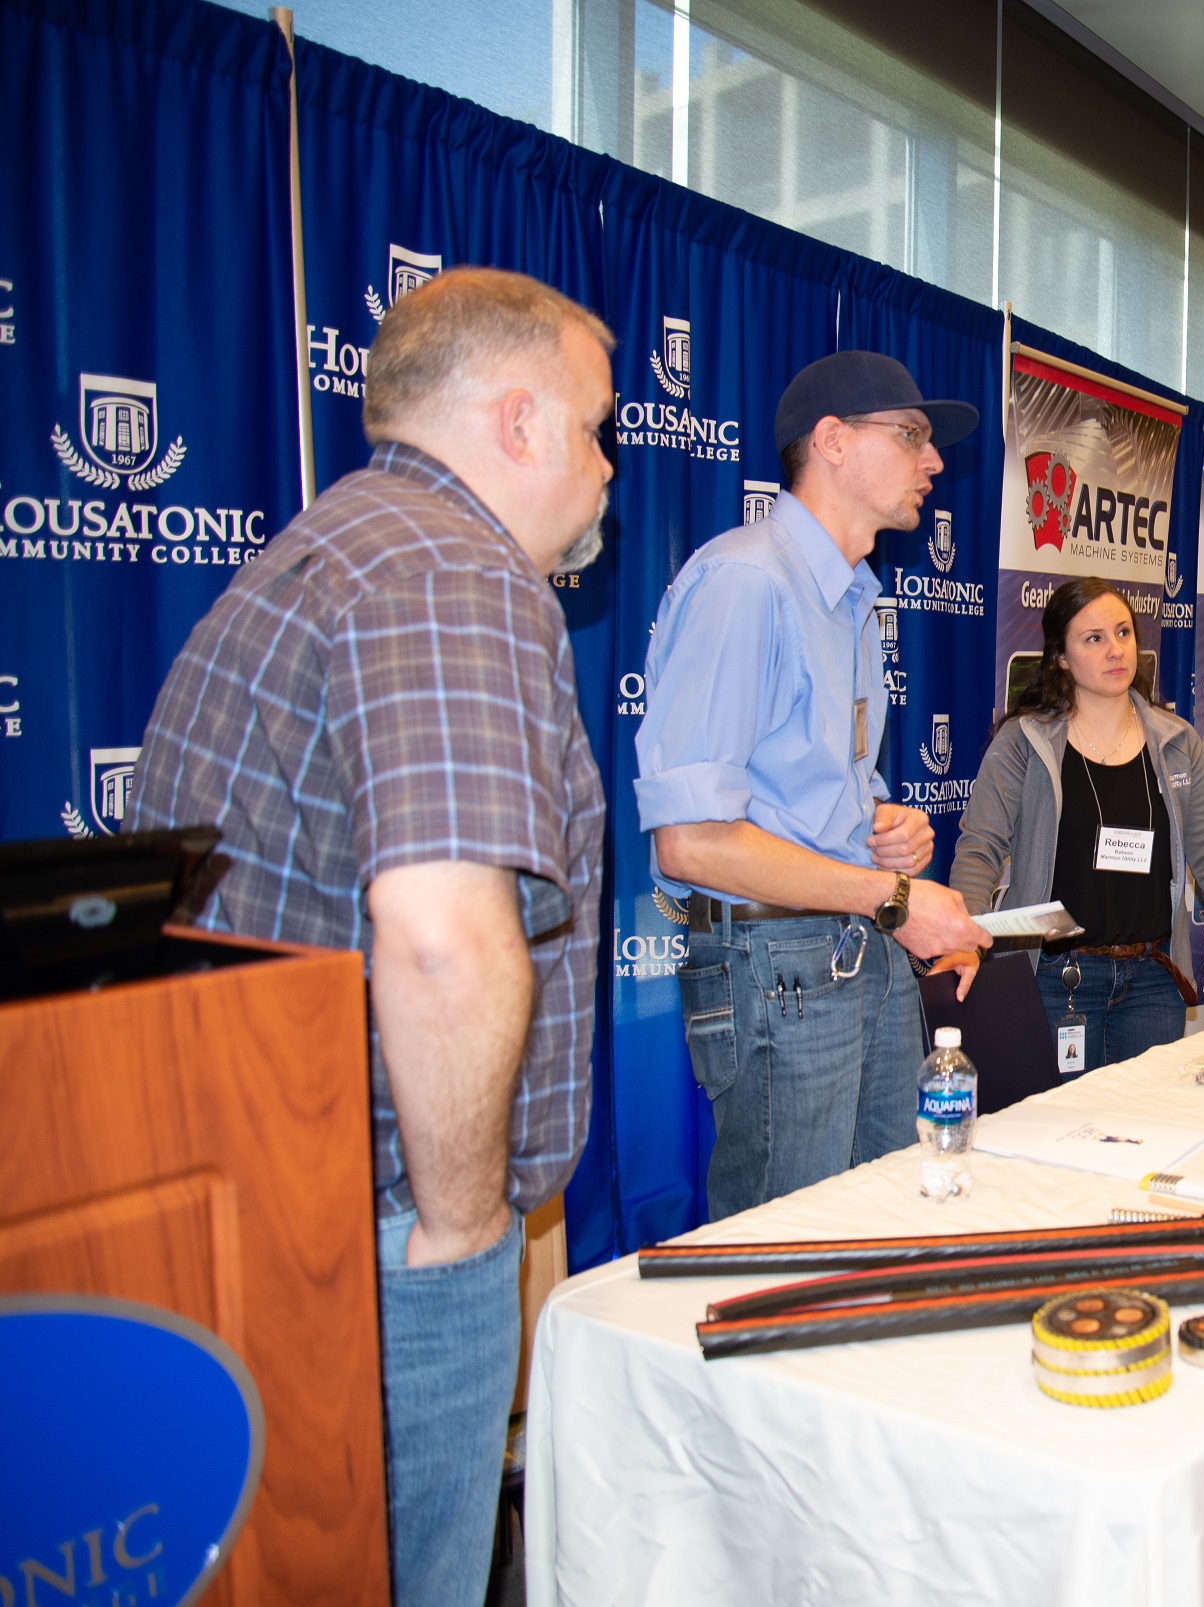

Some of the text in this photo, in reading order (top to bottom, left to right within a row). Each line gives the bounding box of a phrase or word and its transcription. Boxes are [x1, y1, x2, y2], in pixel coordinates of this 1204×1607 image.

[111, 453, 136, 466] 1967
[0, 496, 266, 544] OUSATONIC
[1071, 483, 1168, 551] ARTEC
[0, 538, 140, 562] MMUNITY
[1070, 543, 1163, 567] MACHINE SYSTEMS
[1104, 838, 1146, 849] Rebecca
[924, 1097, 971, 1114] AQUAFINA
